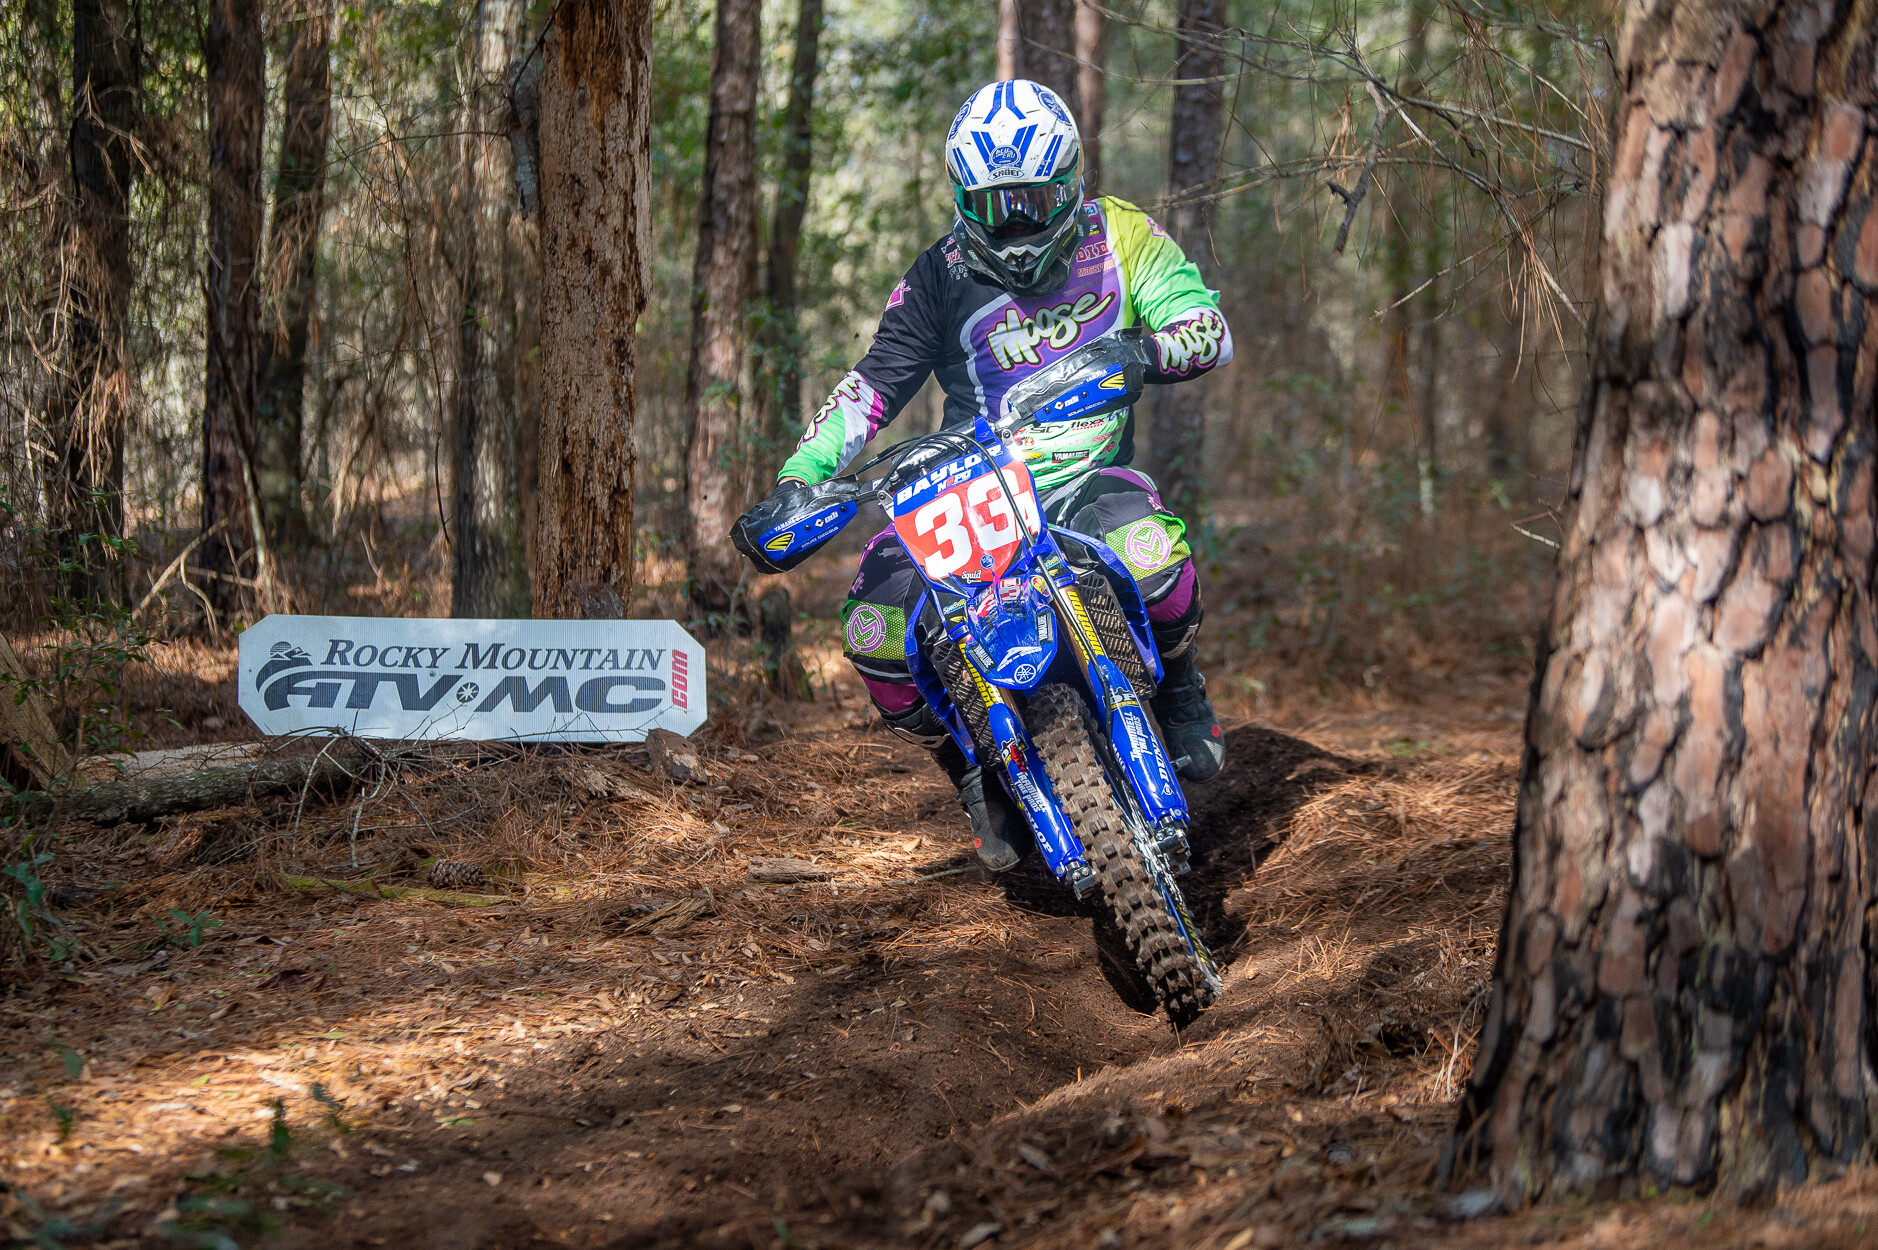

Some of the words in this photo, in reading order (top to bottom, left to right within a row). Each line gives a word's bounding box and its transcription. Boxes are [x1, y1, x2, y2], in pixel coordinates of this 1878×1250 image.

[985, 290, 1117, 372] Moose
[1152, 312, 1226, 376] Moose
[320, 638, 451, 671] ROCKY
[455, 642, 667, 671] MOUNTAIN
[1023, 808, 1054, 854] NLOP
